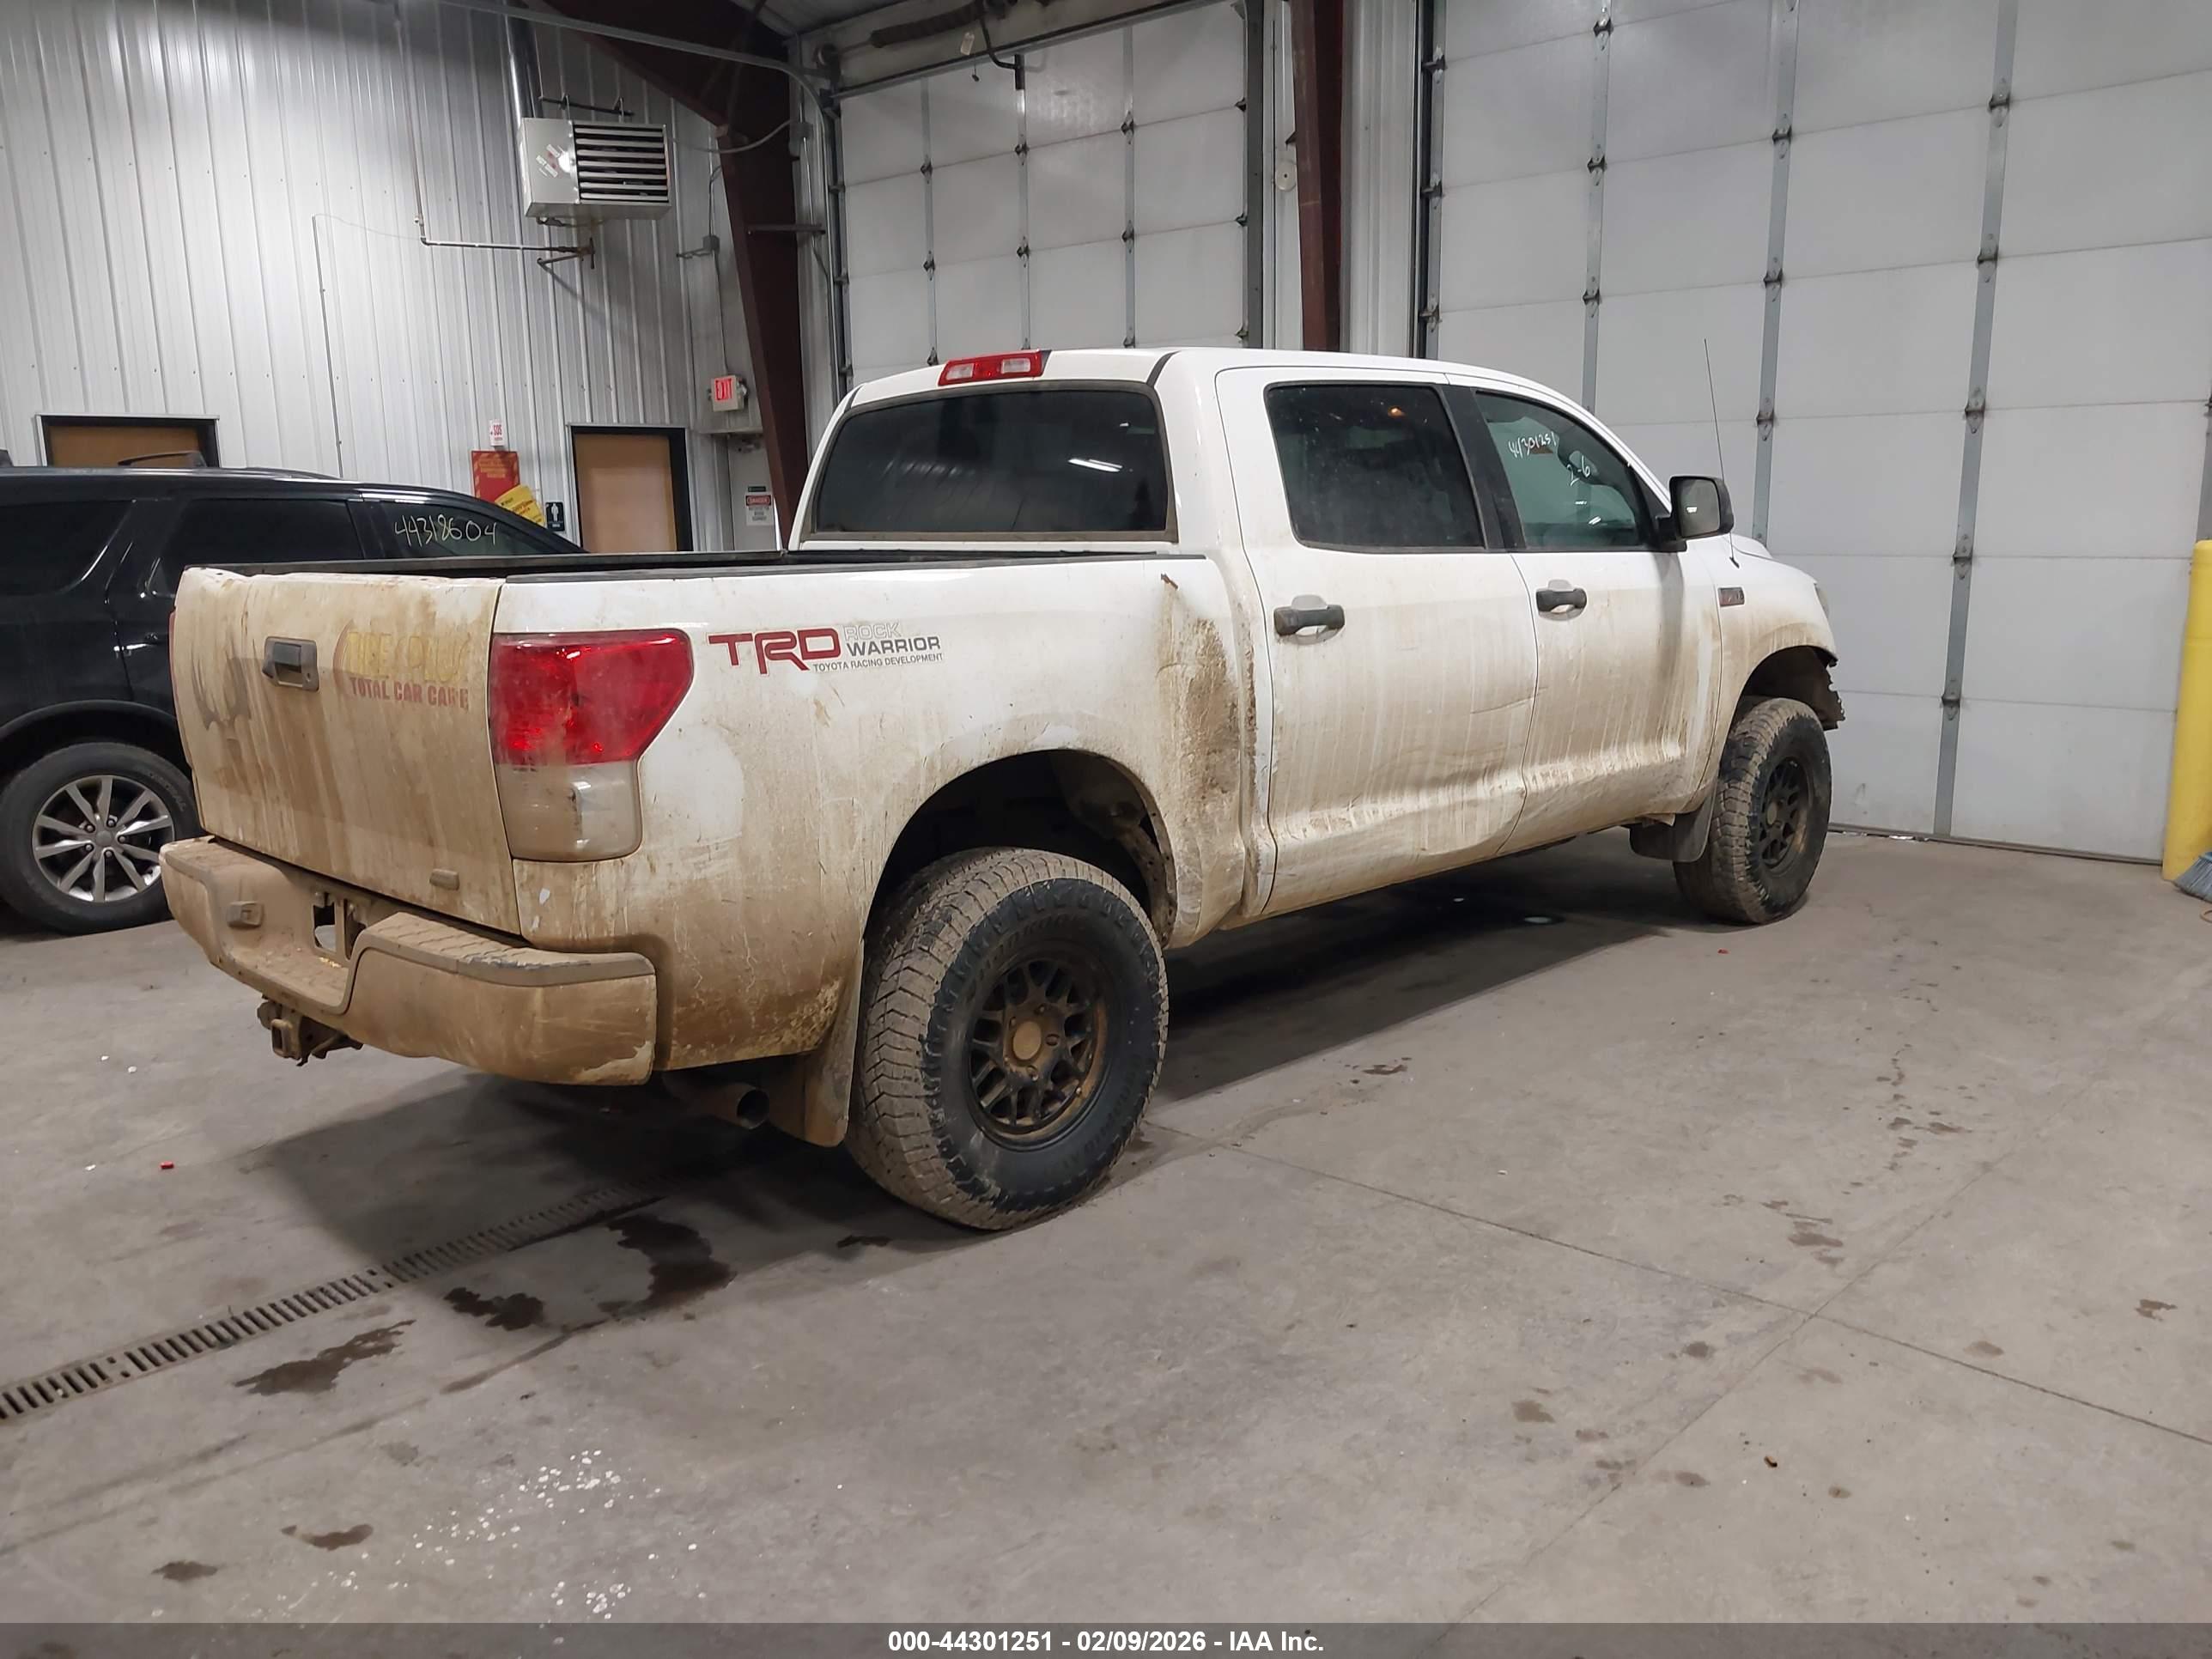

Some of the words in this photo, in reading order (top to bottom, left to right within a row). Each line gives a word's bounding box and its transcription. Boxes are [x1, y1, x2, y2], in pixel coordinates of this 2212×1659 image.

[714, 378, 732, 401] EXIT
[394, 514, 498, 548] 44318604
[843, 622, 902, 641] ROCK
[708, 628, 842, 675] TRD
[846, 636, 941, 657] WARRIOR
[812, 660, 848, 673] TOYOTA
[850, 658, 884, 670] RACING
[884, 653, 944, 667] DEVELOPMENT
[348, 676, 390, 698] TOTAL
[392, 682, 422, 702] CAR
